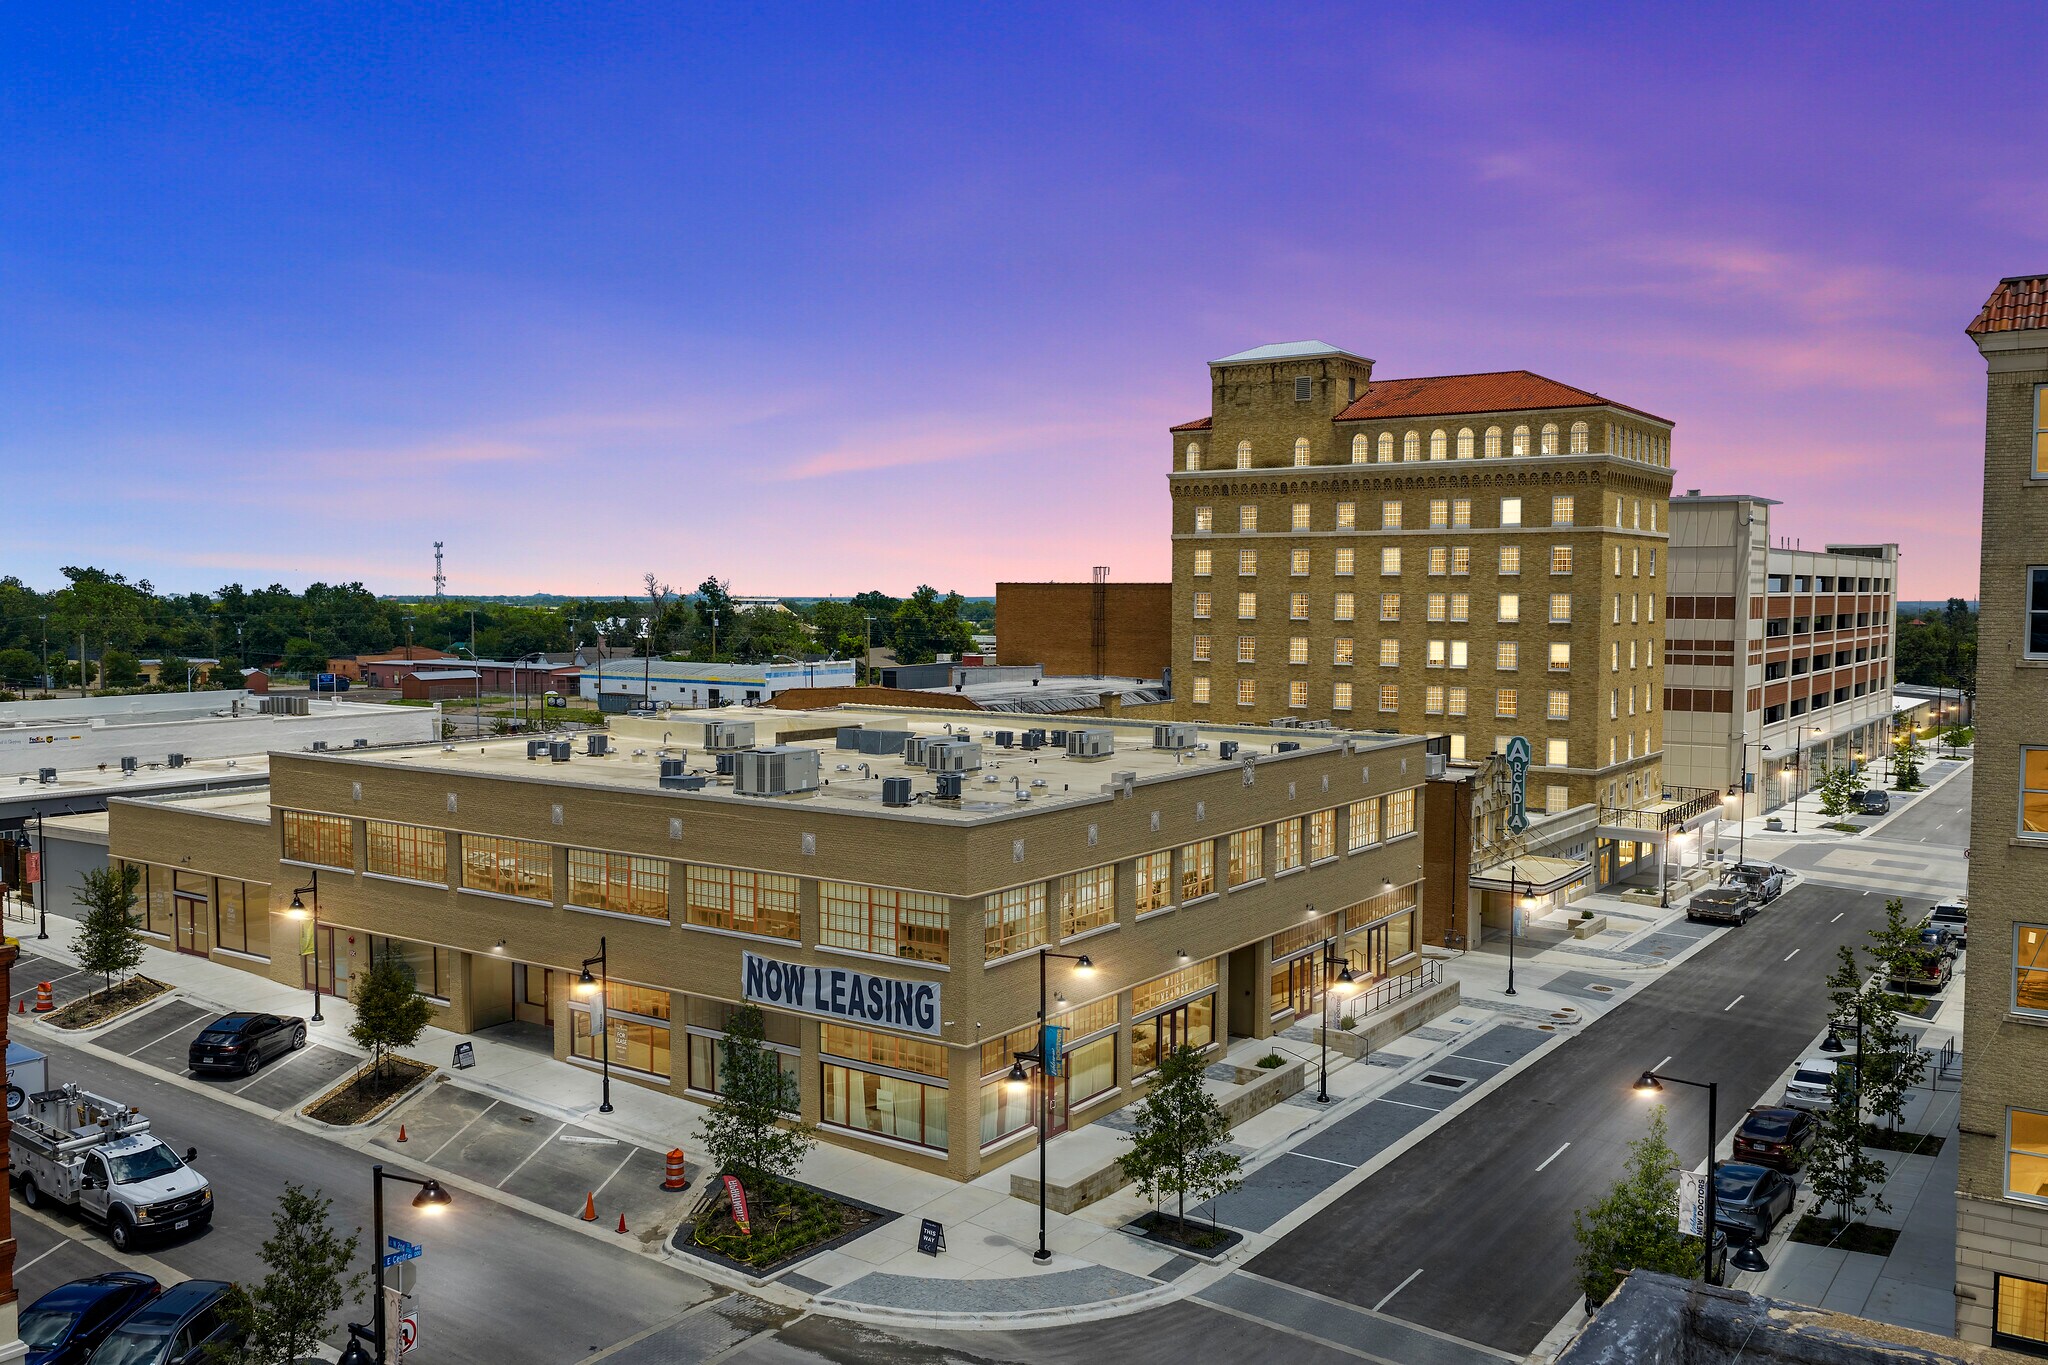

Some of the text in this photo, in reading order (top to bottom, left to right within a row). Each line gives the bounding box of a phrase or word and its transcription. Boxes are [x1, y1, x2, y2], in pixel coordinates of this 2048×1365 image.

[1507, 739, 1529, 828] ARCADIA
[746, 955, 935, 1030] NOW LEASING
[616, 1031, 626, 1039] FOR
[1697, 1179, 1705, 1217] DOCTORS
[923, 1227, 937, 1237] THIS
[923, 1234, 935, 1243] WAY
[386, 1257, 391, 1266] E
[392, 1253, 413, 1264] Central
